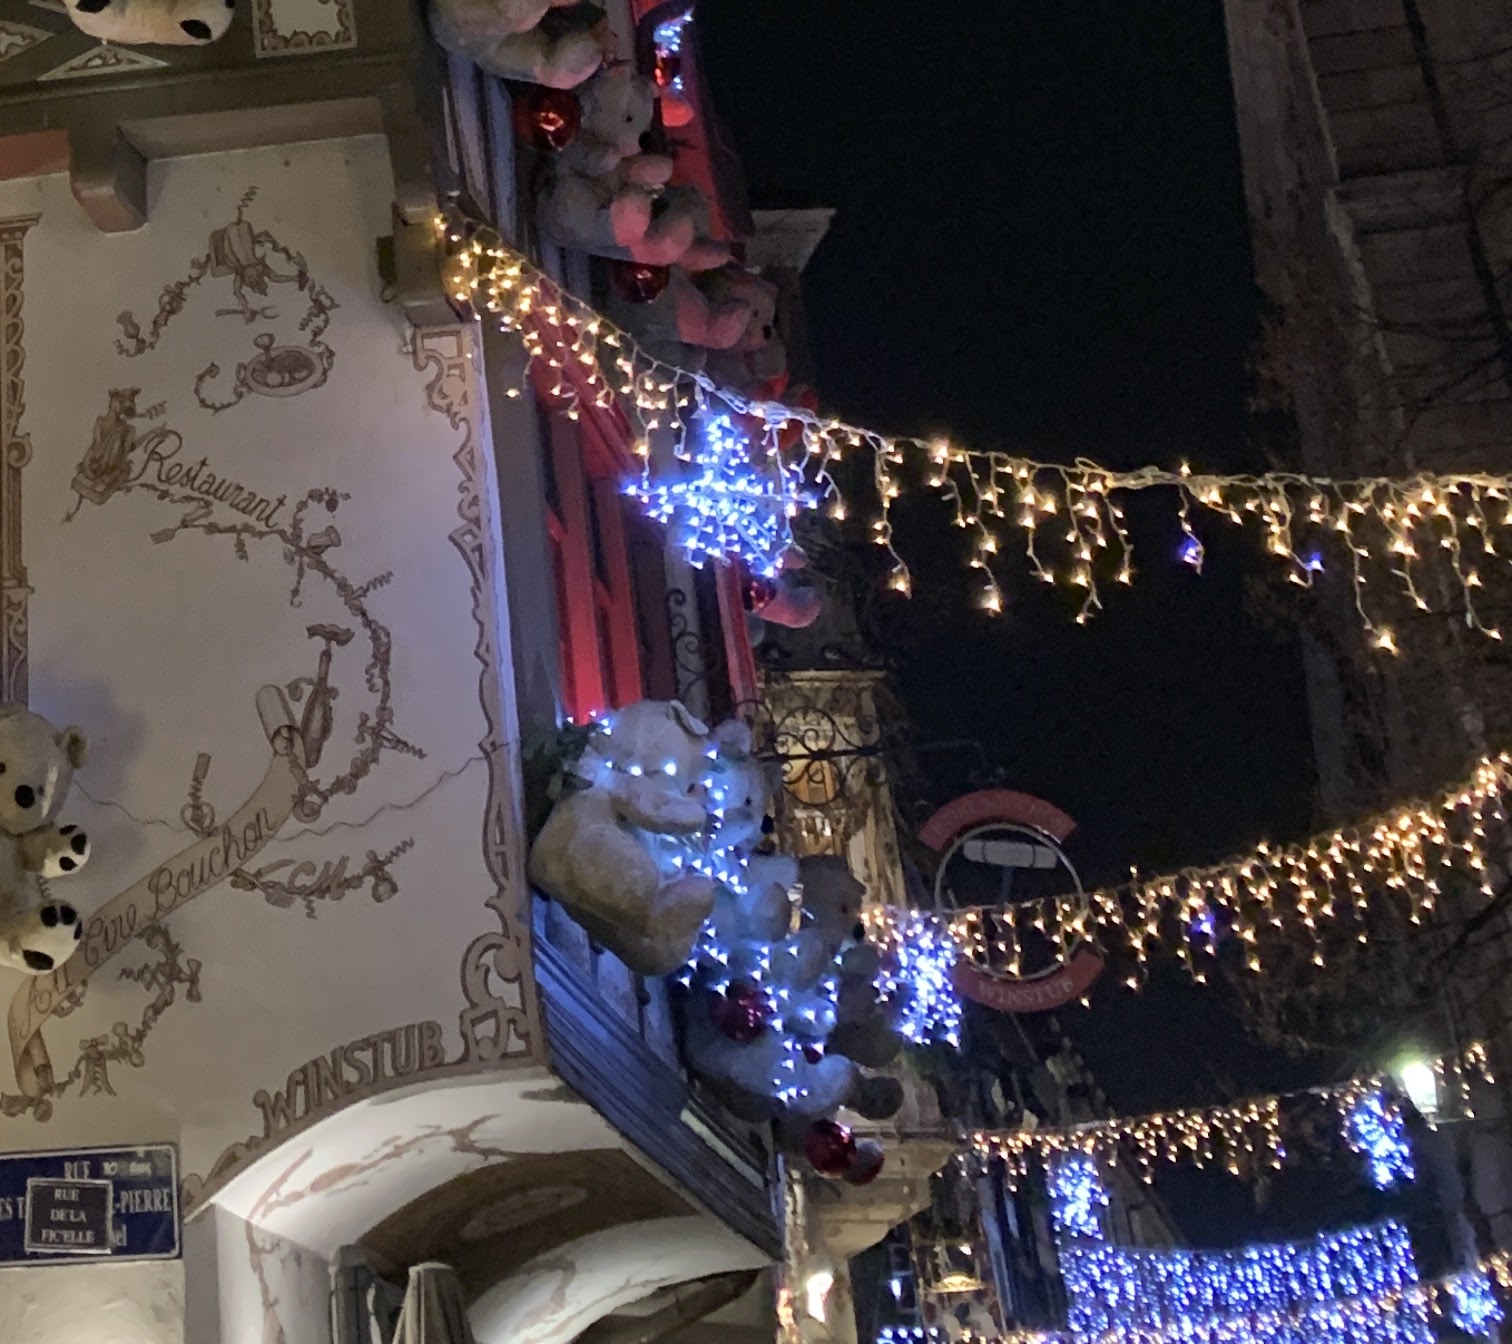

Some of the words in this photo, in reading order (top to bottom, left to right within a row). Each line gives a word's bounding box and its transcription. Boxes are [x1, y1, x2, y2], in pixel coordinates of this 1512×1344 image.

[128, 428, 288, 528] Restaurant
[148, 807, 277, 920] Bouchon
[252, 1019, 446, 1140] WINSTUB
[54, 1188, 80, 1202] RUE
